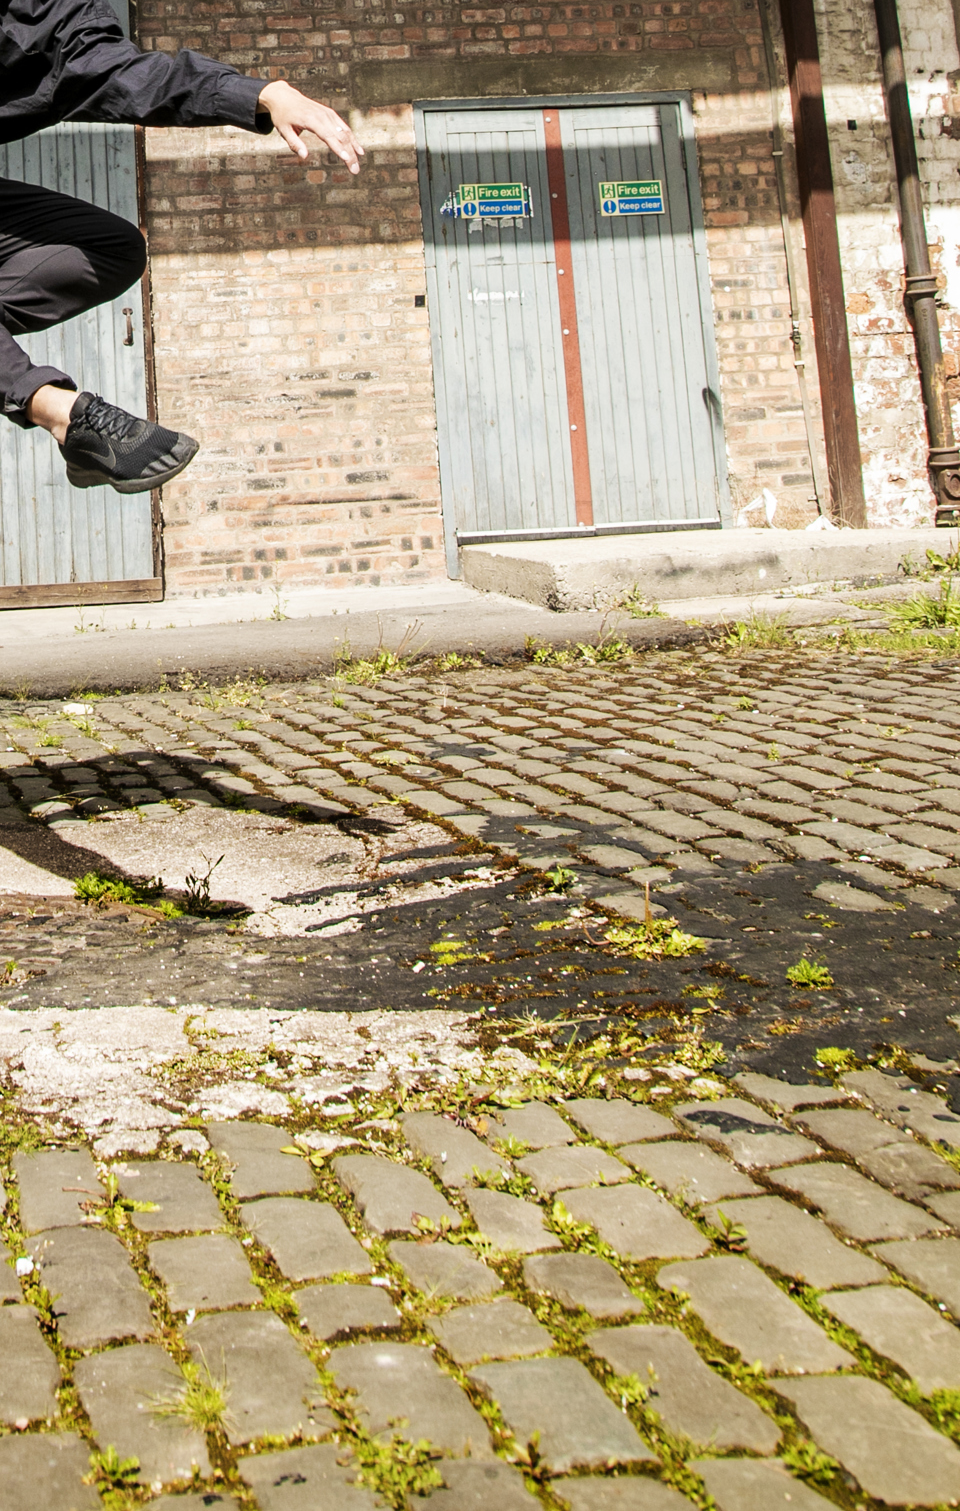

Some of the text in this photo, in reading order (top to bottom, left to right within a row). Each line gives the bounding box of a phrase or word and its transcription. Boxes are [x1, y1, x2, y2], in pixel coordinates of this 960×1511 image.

[479, 187, 520, 197] Fire exit
[618, 184, 659, 195] Fire exit
[480, 204, 521, 213] Keep clear
[620, 201, 661, 210] Keep clear
